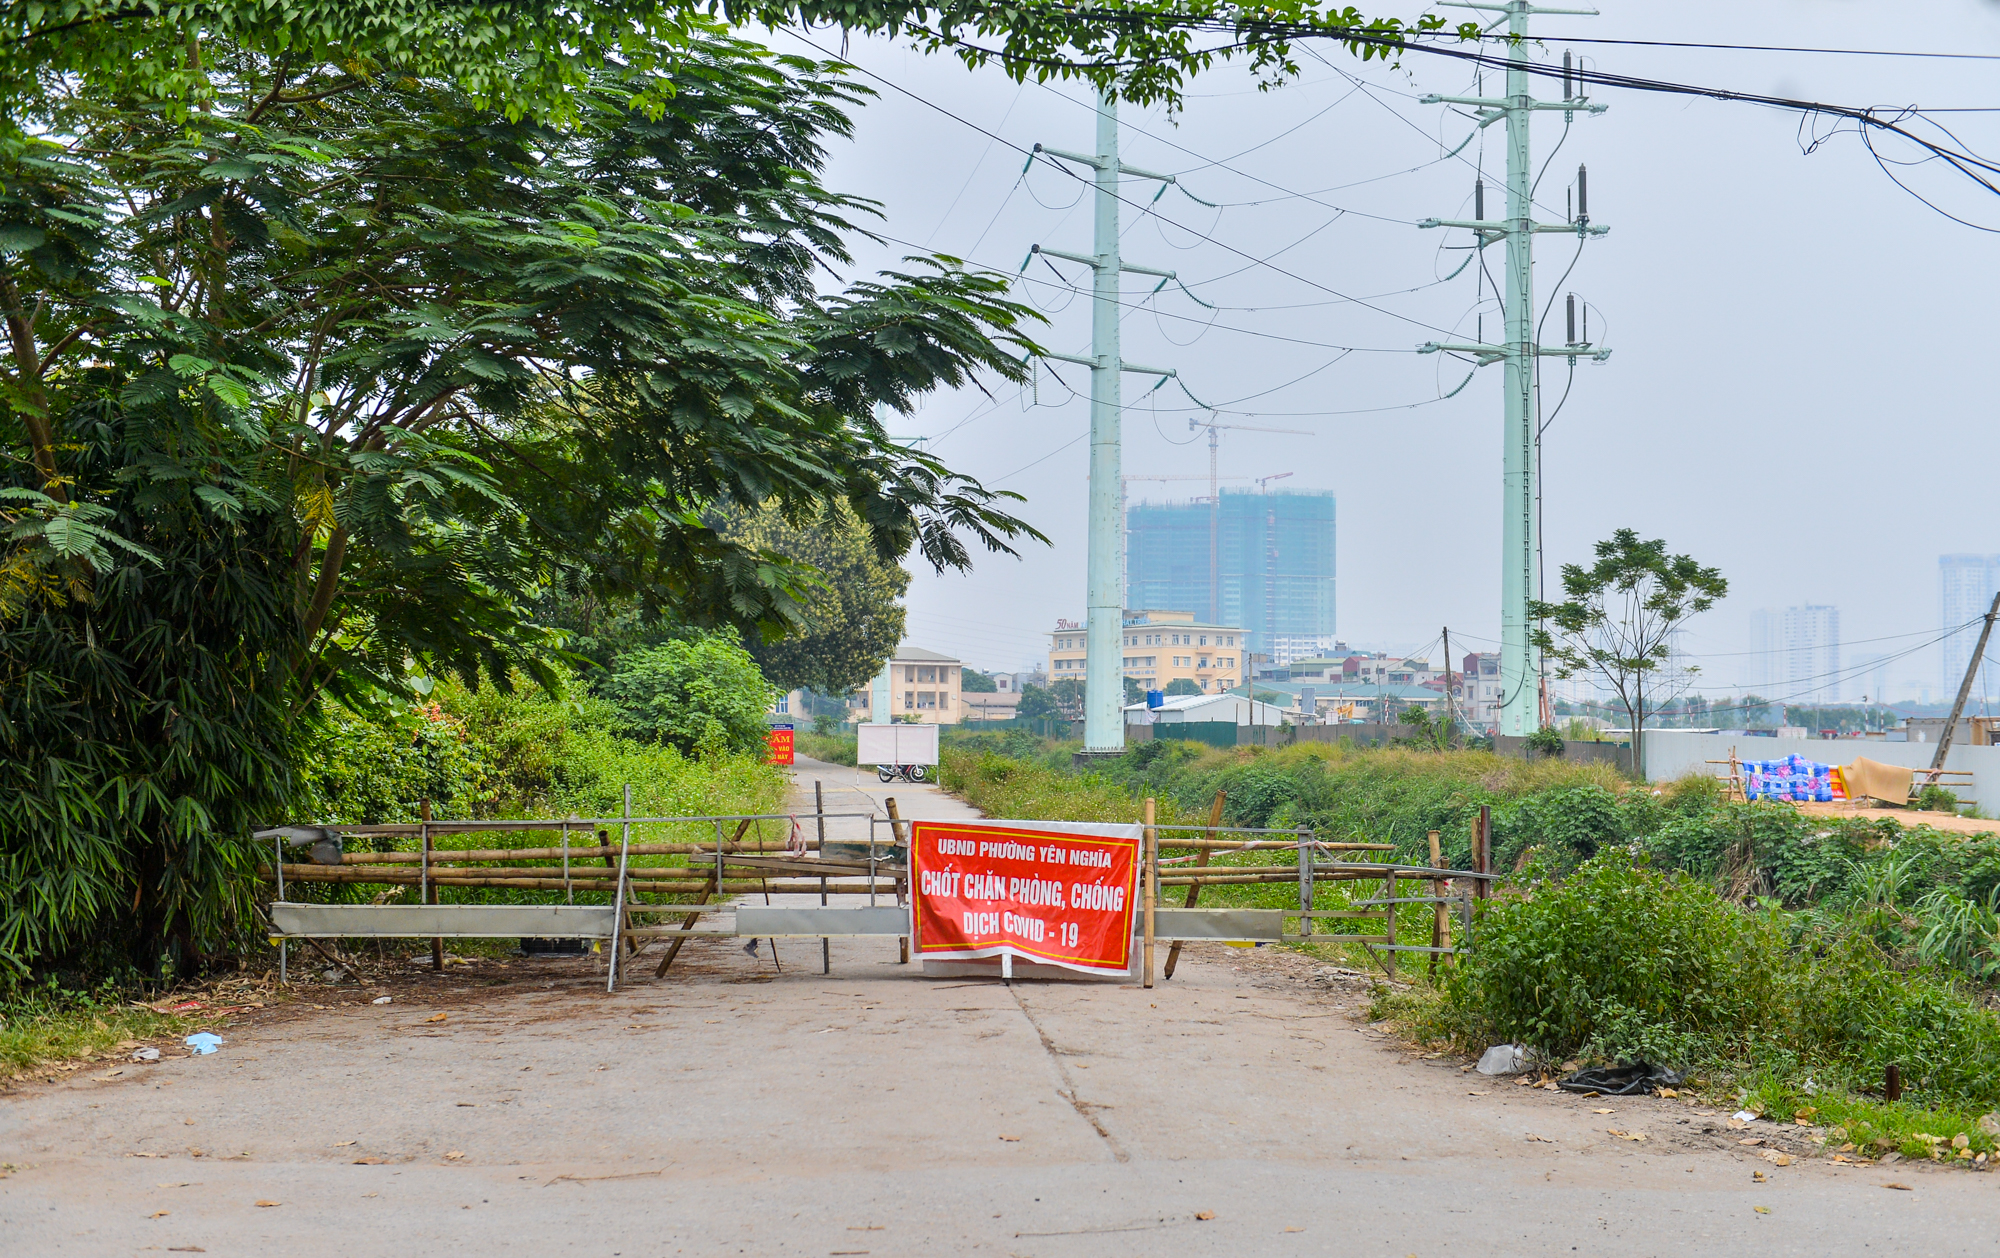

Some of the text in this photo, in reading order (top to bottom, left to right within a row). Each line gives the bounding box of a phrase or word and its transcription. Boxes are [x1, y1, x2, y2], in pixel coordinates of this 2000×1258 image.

[1055, 619, 1067, 630] 50
[937, 838, 1112, 868] UBND PHƯỜNG YÊN NGHĨA
[921, 863, 1124, 912] CHỐT CHẶN PHÒNG, CHỐNG
[963, 911, 1000, 940] DỊCH
[1003, 911, 1044, 943] COVID
[1060, 922, 1079, 948] 19
